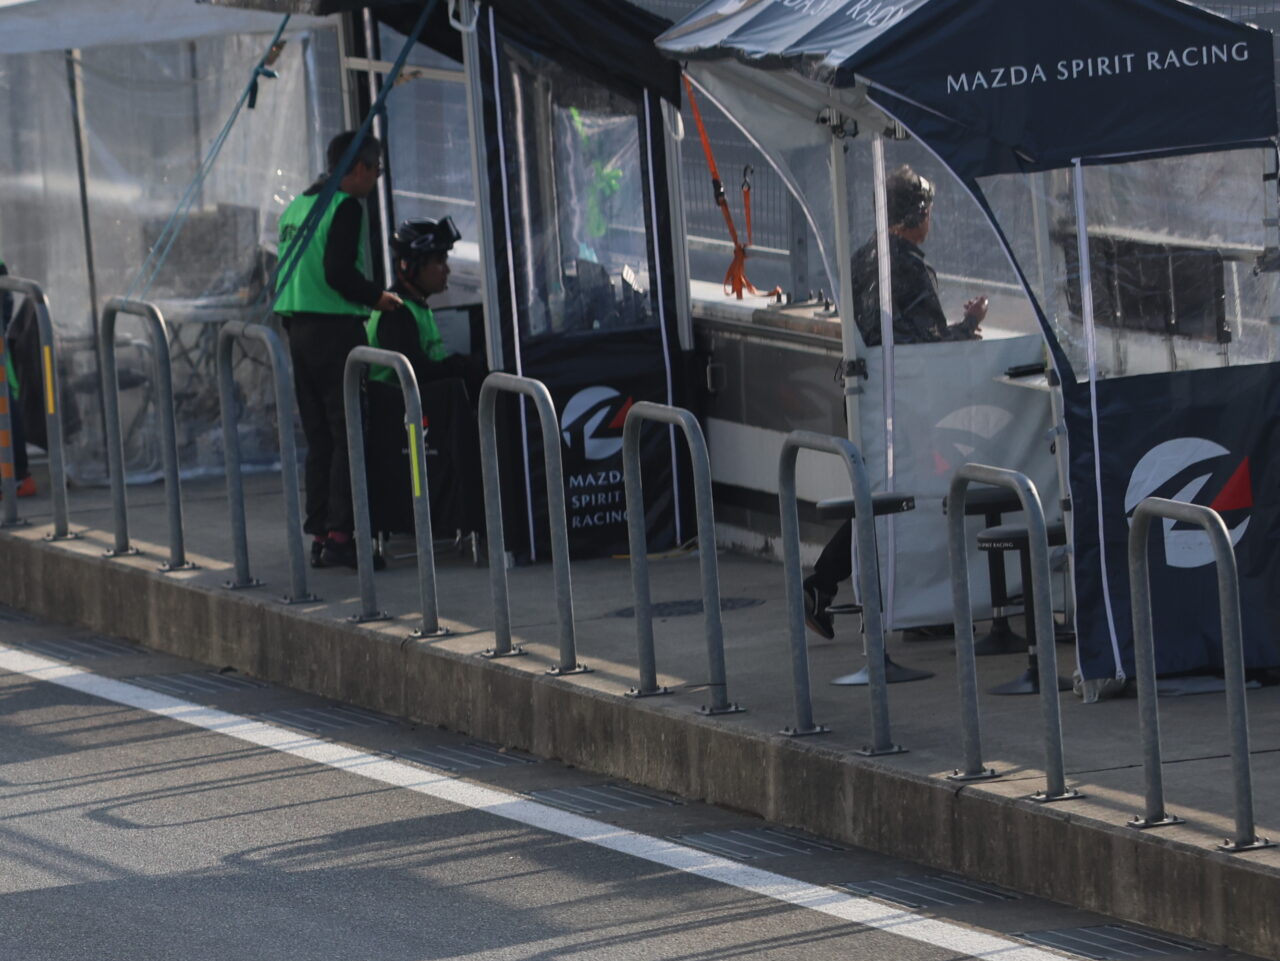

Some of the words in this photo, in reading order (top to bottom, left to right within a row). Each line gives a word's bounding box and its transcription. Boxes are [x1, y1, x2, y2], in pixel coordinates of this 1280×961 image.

[946, 64, 1047, 94] MAZDA
[1056, 54, 1135, 81] SPIRIT
[1146, 42, 1249, 71] RACING
[569, 470, 625, 488] MAZD
[571, 490, 621, 509] SPIRIT
